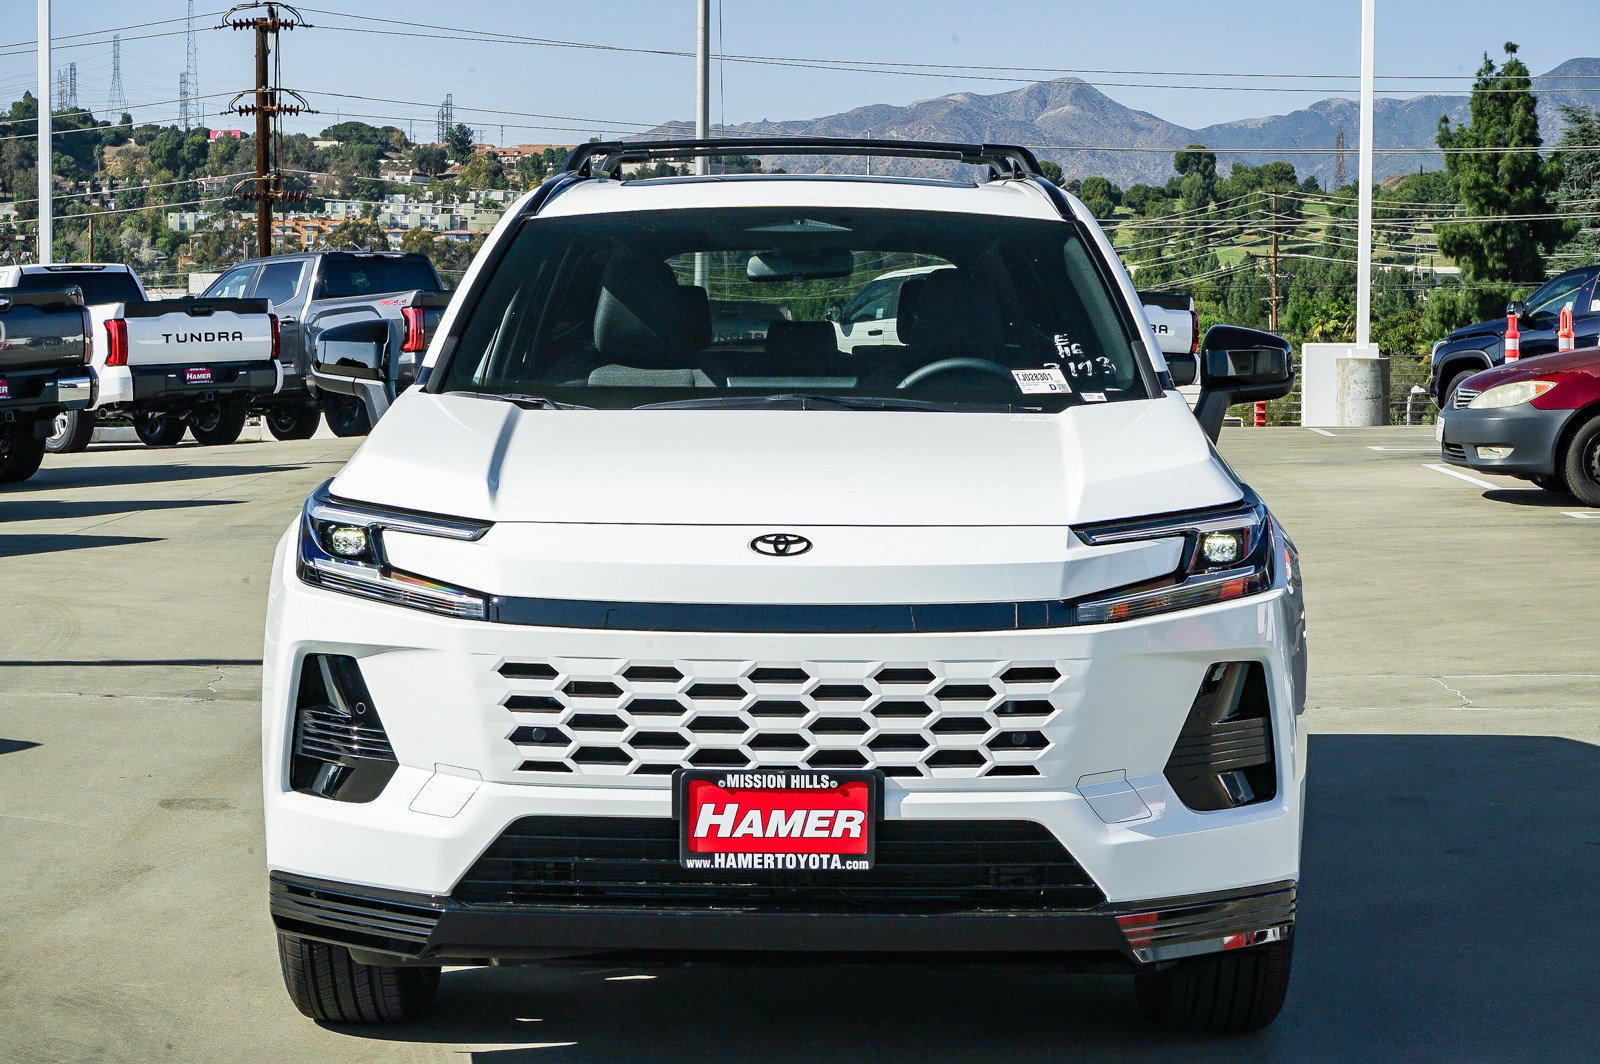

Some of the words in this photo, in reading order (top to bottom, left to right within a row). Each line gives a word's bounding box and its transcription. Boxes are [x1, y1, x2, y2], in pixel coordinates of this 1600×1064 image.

[162, 331, 243, 343] TUNDRA
[726, 774, 786, 789] MISSION
[790, 775, 830, 789] HILLS
[693, 803, 866, 839] HAMER
[686, 853, 869, 870] www.HAMERTOYOTA.com
